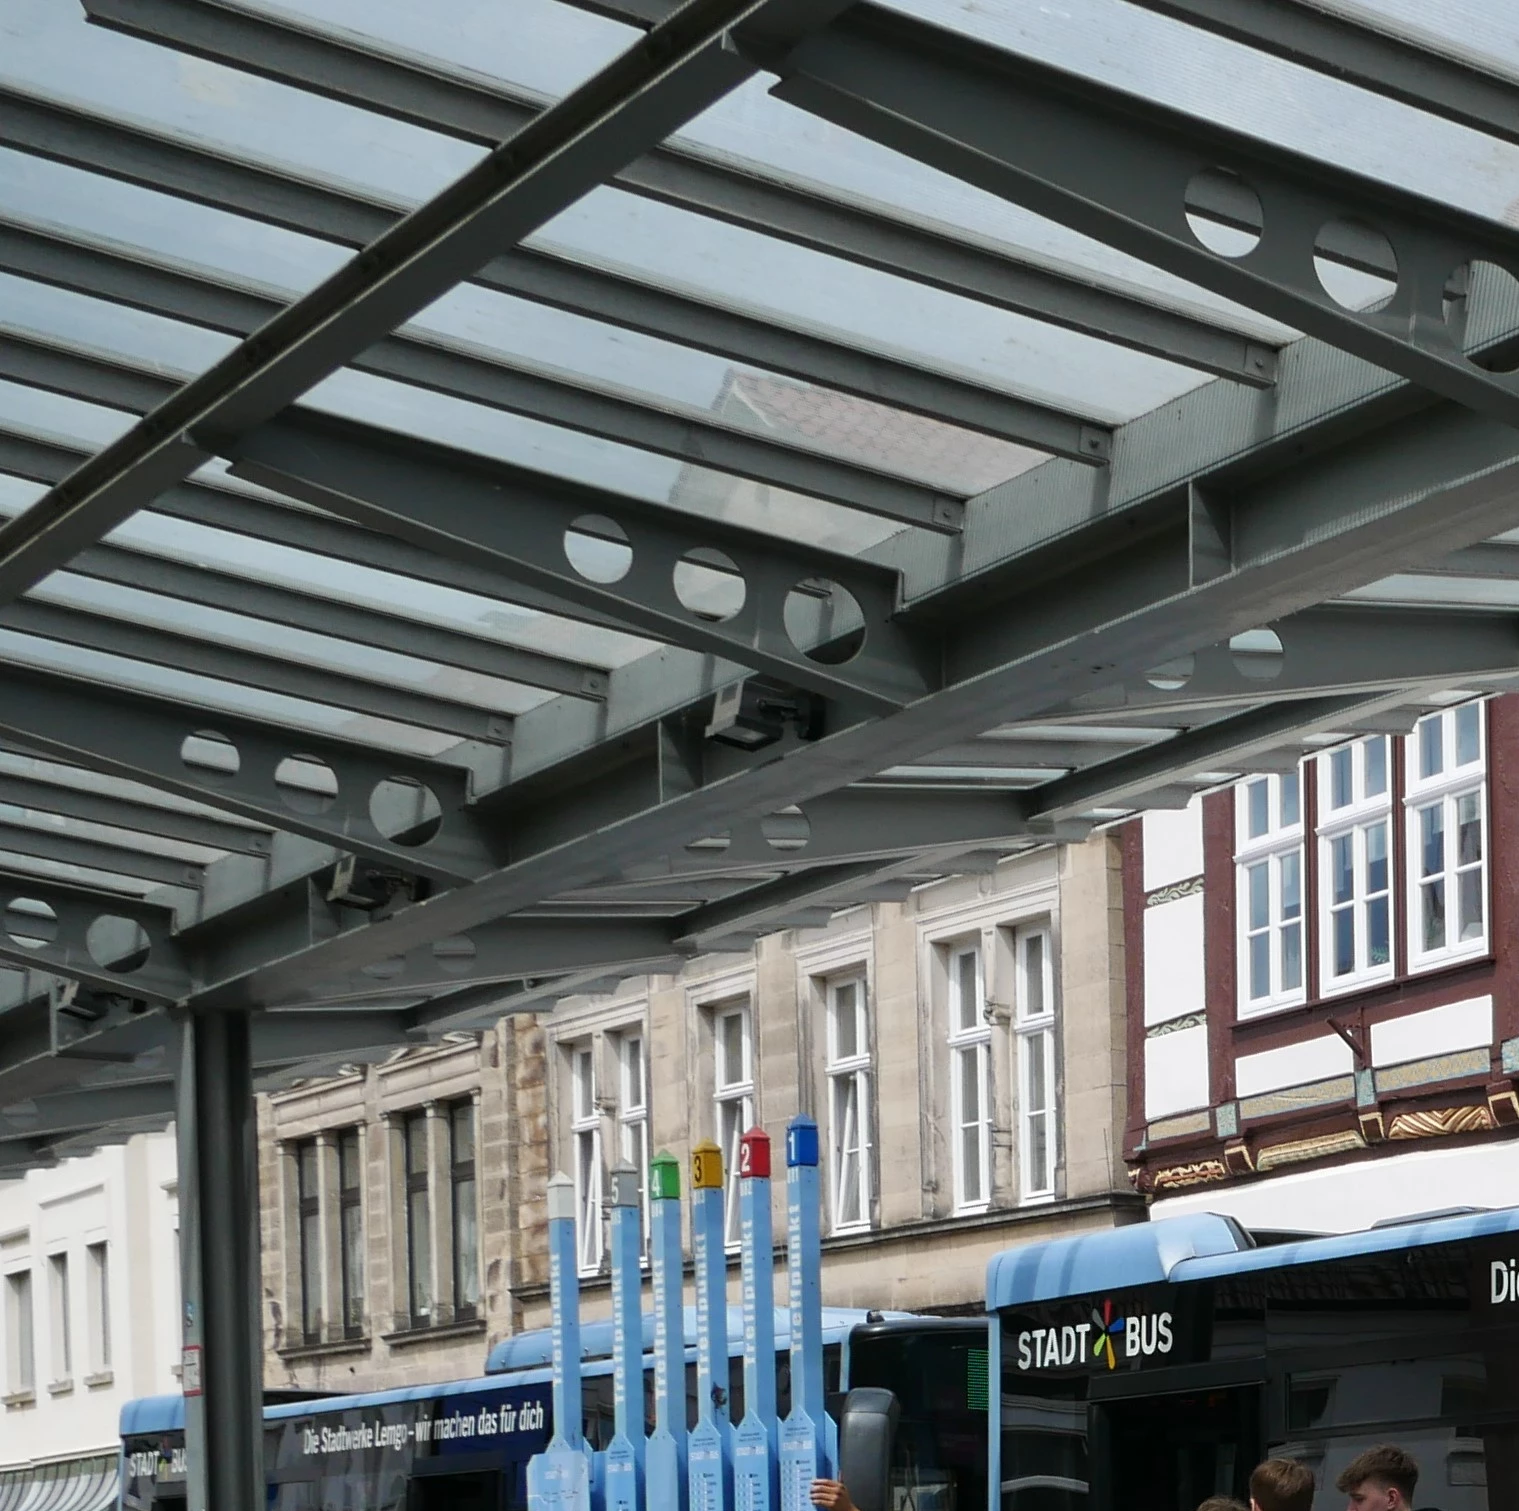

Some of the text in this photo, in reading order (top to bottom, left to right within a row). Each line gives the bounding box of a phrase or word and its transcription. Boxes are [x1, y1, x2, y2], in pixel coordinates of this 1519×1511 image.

[694, 1155, 702, 1182] 3
[741, 1143, 751, 1173] 2
[787, 1132, 797, 1161] 1
[611, 1177, 620, 1204] 5
[651, 1169, 661, 1198] 4
[694, 1233, 709, 1377] Treffpunkt
[741, 1219, 755, 1368] Treffpunkt
[788, 1203, 803, 1355] Treffpunkt
[551, 1253, 563, 1389] Treffpunkt
[613, 1268, 625, 1403] Treffpunkt
[652, 1259, 667, 1399] Treffpunkt
[1017, 1312, 1173, 1370] STADT BUS
[303, 1428, 319, 1454] Die
[321, 1422, 373, 1453] Stadtwerke
[375, 1420, 408, 1451] Lemgo
[416, 1414, 431, 1442] wir
[434, 1410, 475, 1439] machen
[478, 1407, 497, 1435] das
[500, 1404, 516, 1433] für
[519, 1400, 543, 1431] dich
[129, 1451, 160, 1478] STADT
